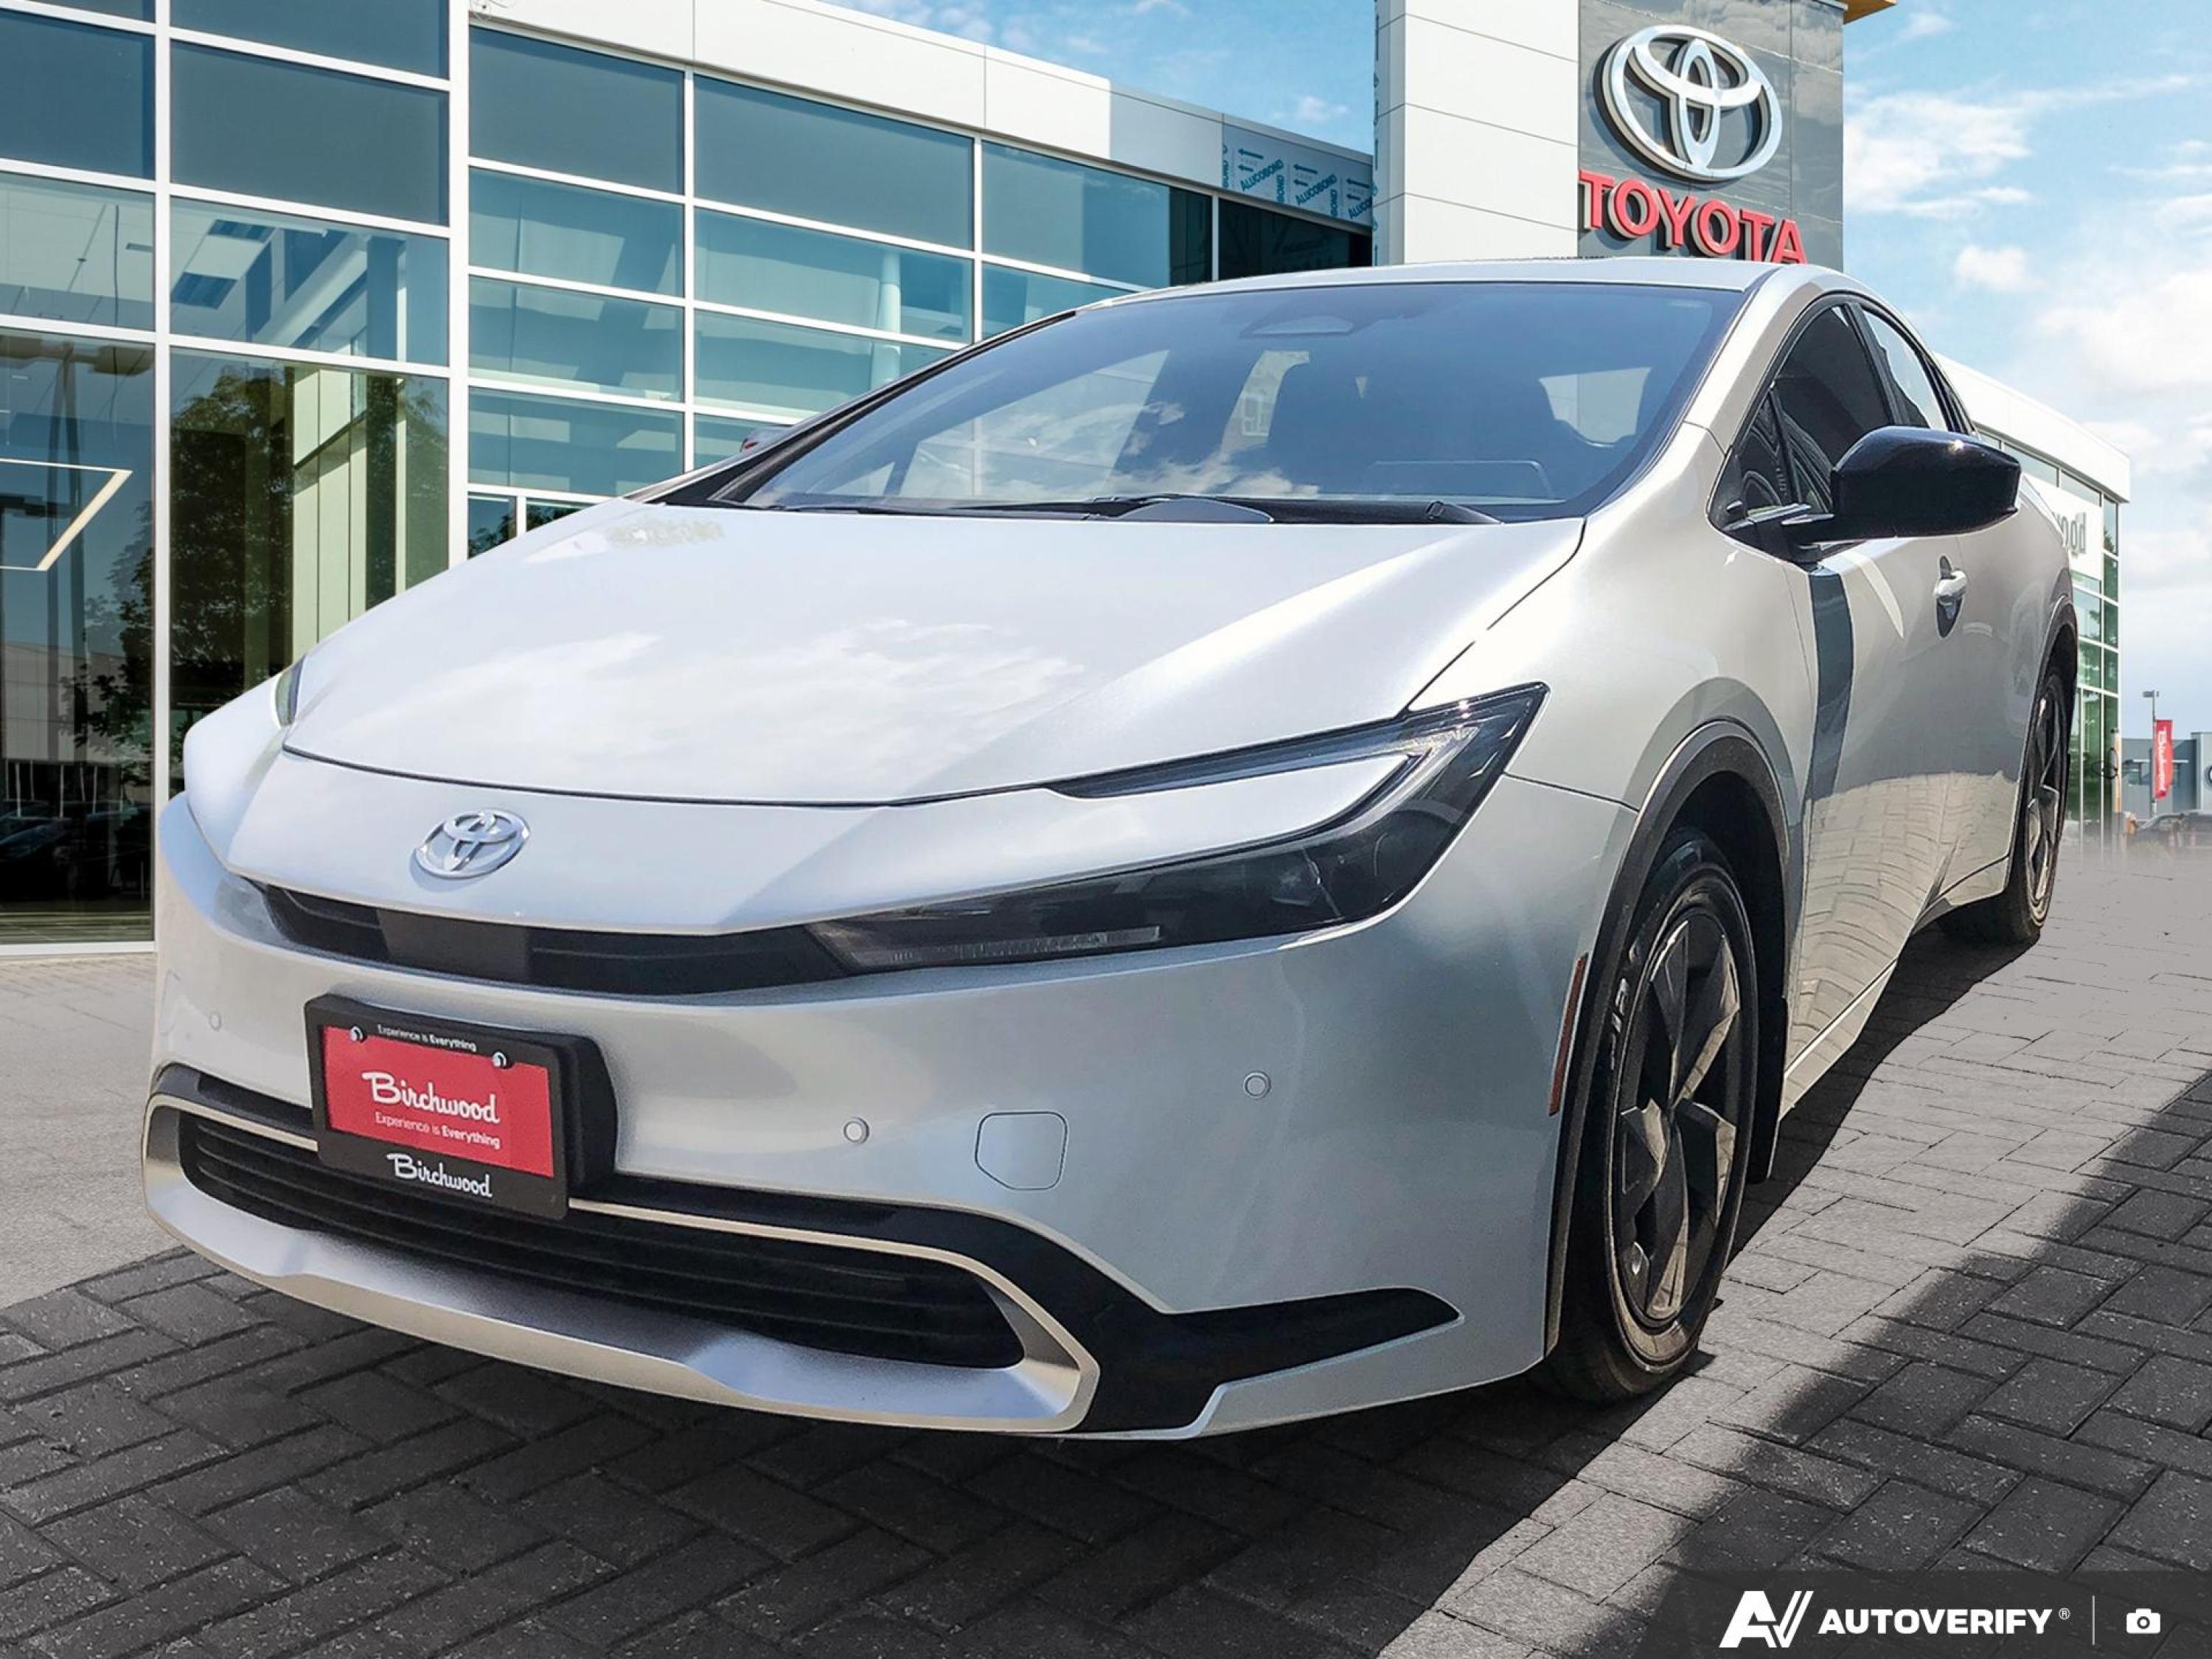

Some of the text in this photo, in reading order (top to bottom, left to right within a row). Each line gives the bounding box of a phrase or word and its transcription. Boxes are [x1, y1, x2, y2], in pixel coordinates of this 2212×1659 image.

[1239, 159, 1284, 192] ALUCOBOND
[1294, 173, 1338, 206] ALUCOBOND
[1579, 170, 1808, 264] TOYOTA
[377, 1023, 477, 1052] Experience is Everything
[361, 1071, 501, 1124] Birchwood
[375, 1110, 501, 1150] Experience is Everything
[386, 1152, 493, 1197] Birchwood
